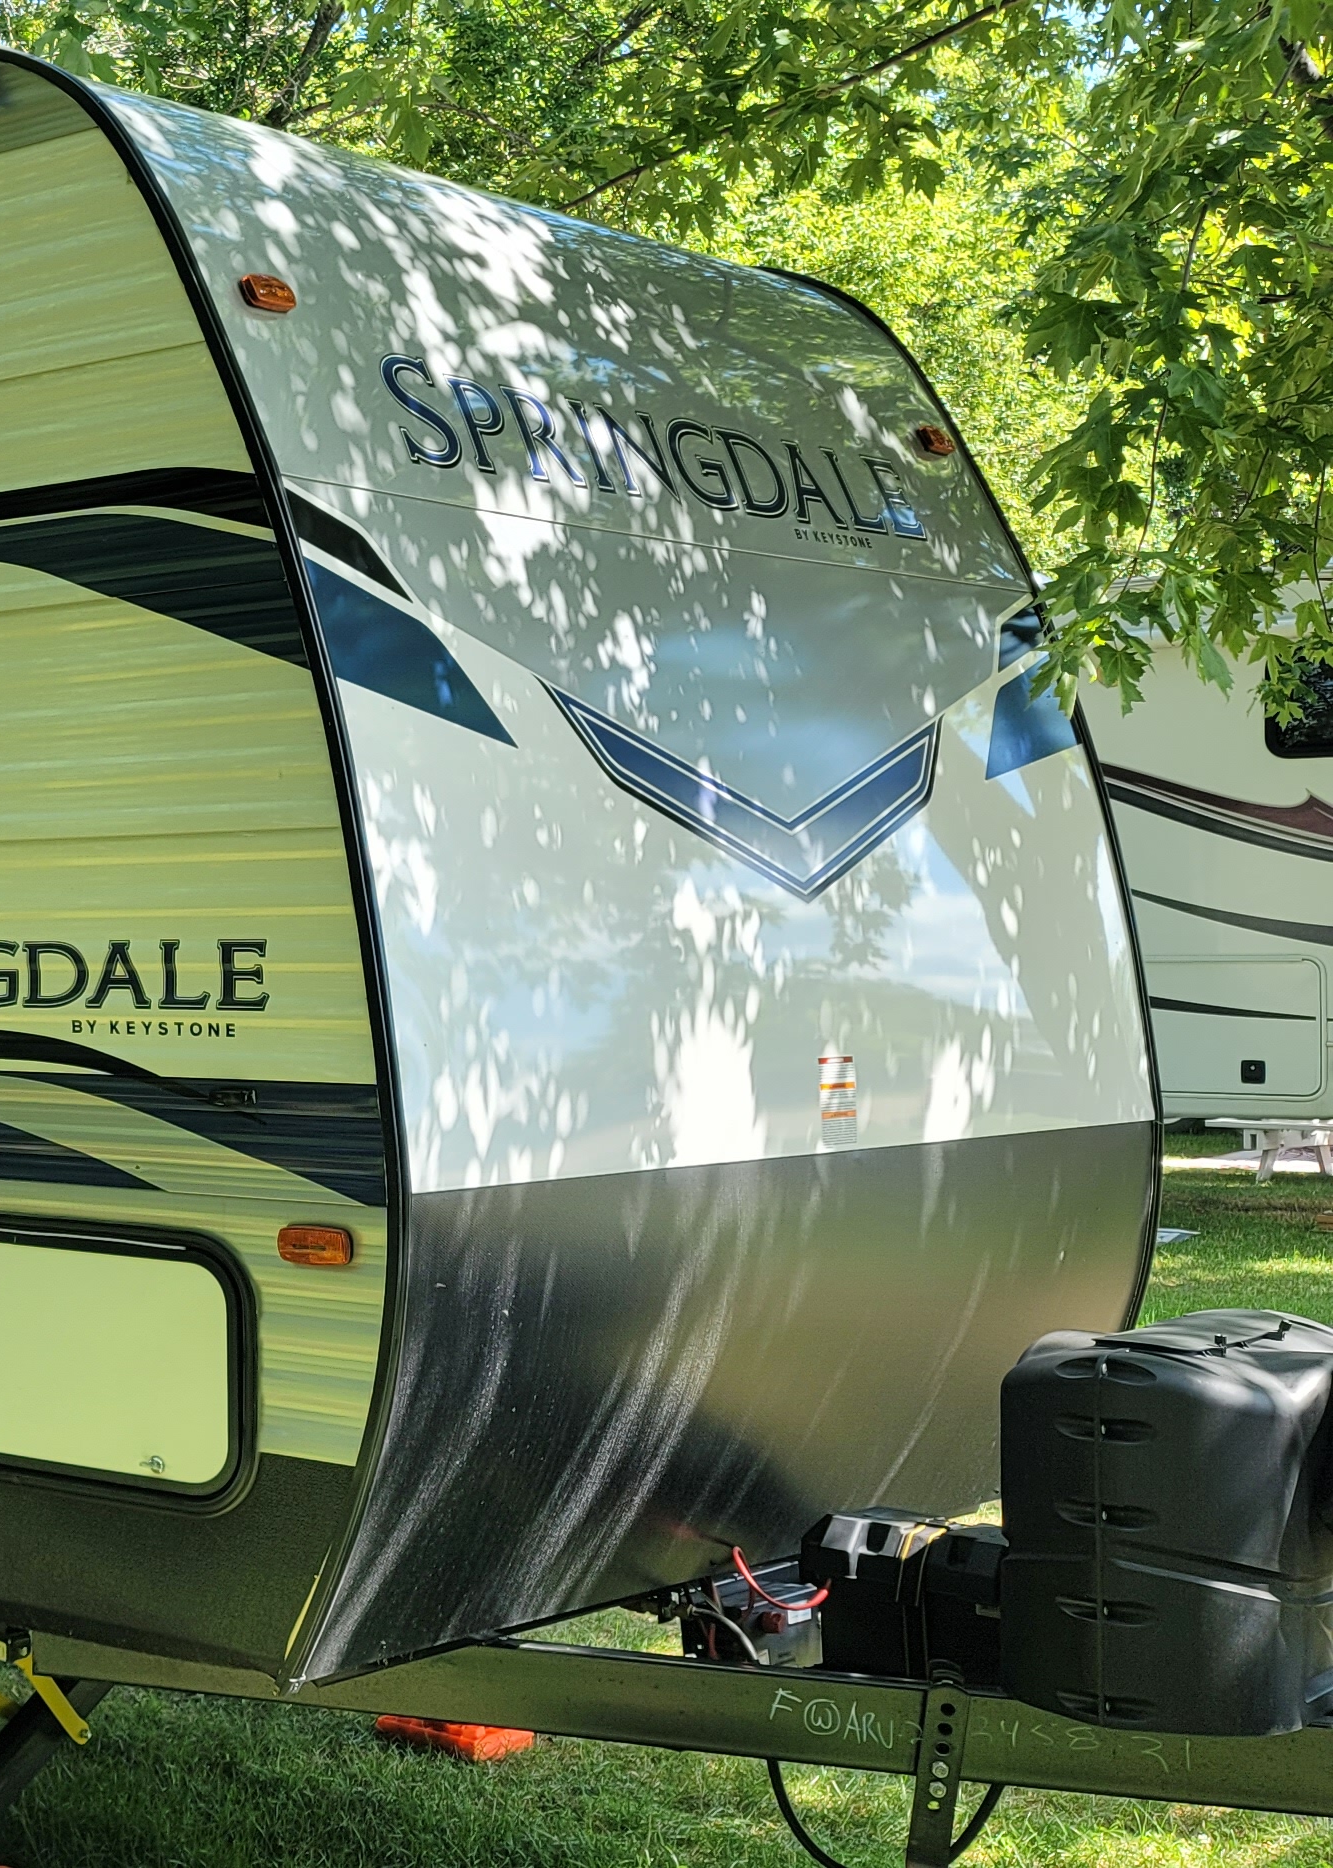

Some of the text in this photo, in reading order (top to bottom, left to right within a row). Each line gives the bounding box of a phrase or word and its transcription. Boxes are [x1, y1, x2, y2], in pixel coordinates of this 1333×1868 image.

[380, 353, 927, 541] SPRINGDALE
[794, 528, 873, 549] BY KEYSTONE
[71, 1019, 236, 1038] BY KEYSTONE
